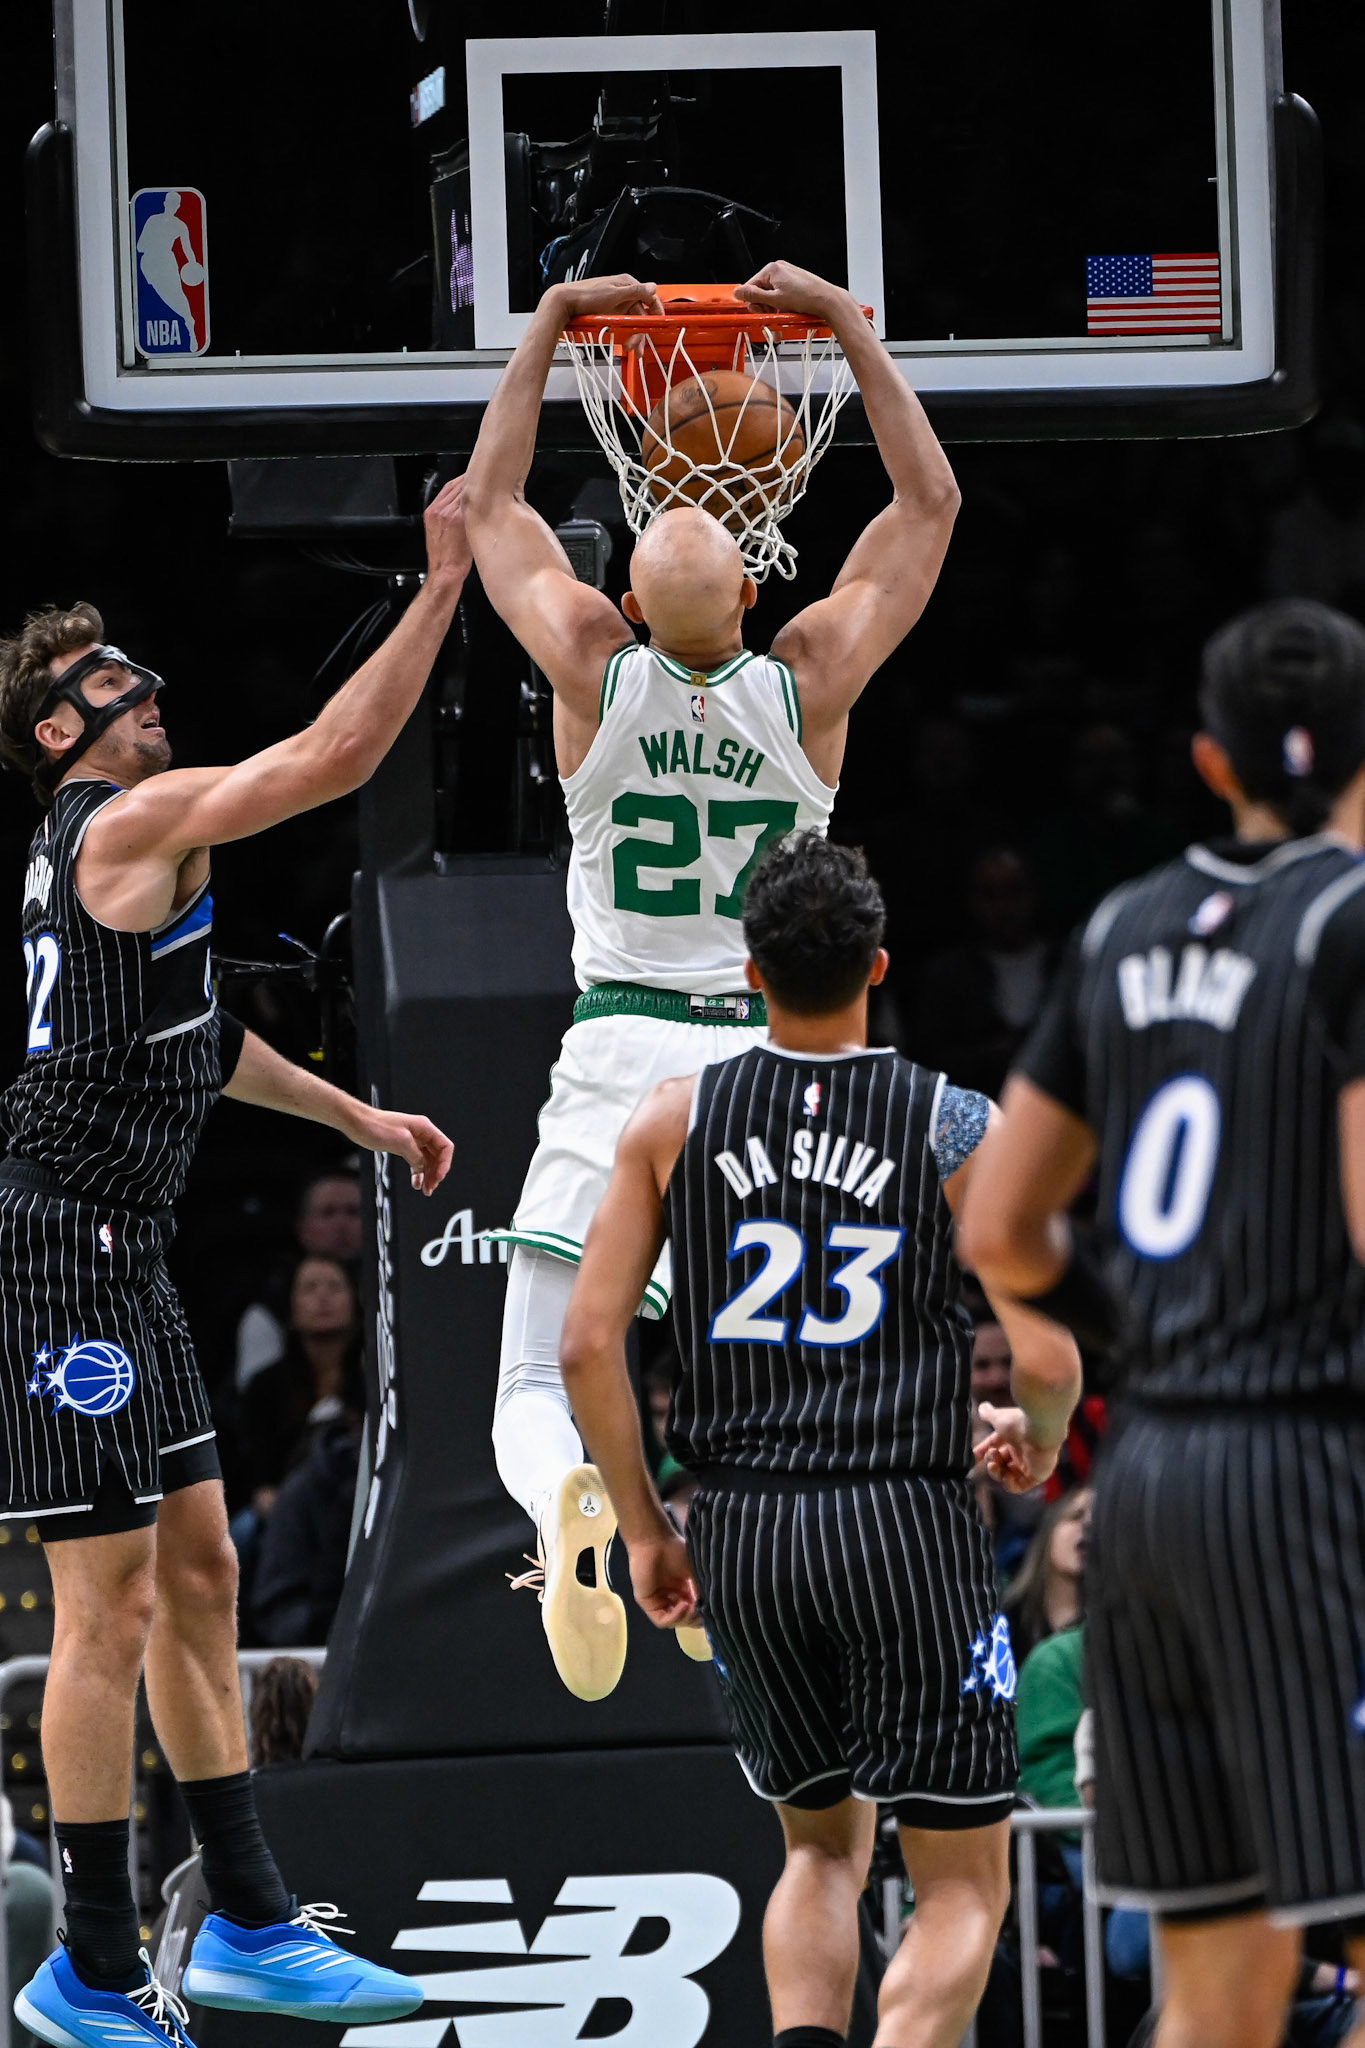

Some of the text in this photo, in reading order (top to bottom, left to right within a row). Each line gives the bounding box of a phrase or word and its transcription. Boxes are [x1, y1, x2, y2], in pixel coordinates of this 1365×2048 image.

[146, 319, 181, 346] NBA
[639, 730, 765, 788] WALSH
[612, 791, 799, 920] 27
[714, 1128, 896, 1208] DA SILVA
[1117, 1070, 1222, 1260] 0
[706, 1217, 906, 1348] 23
